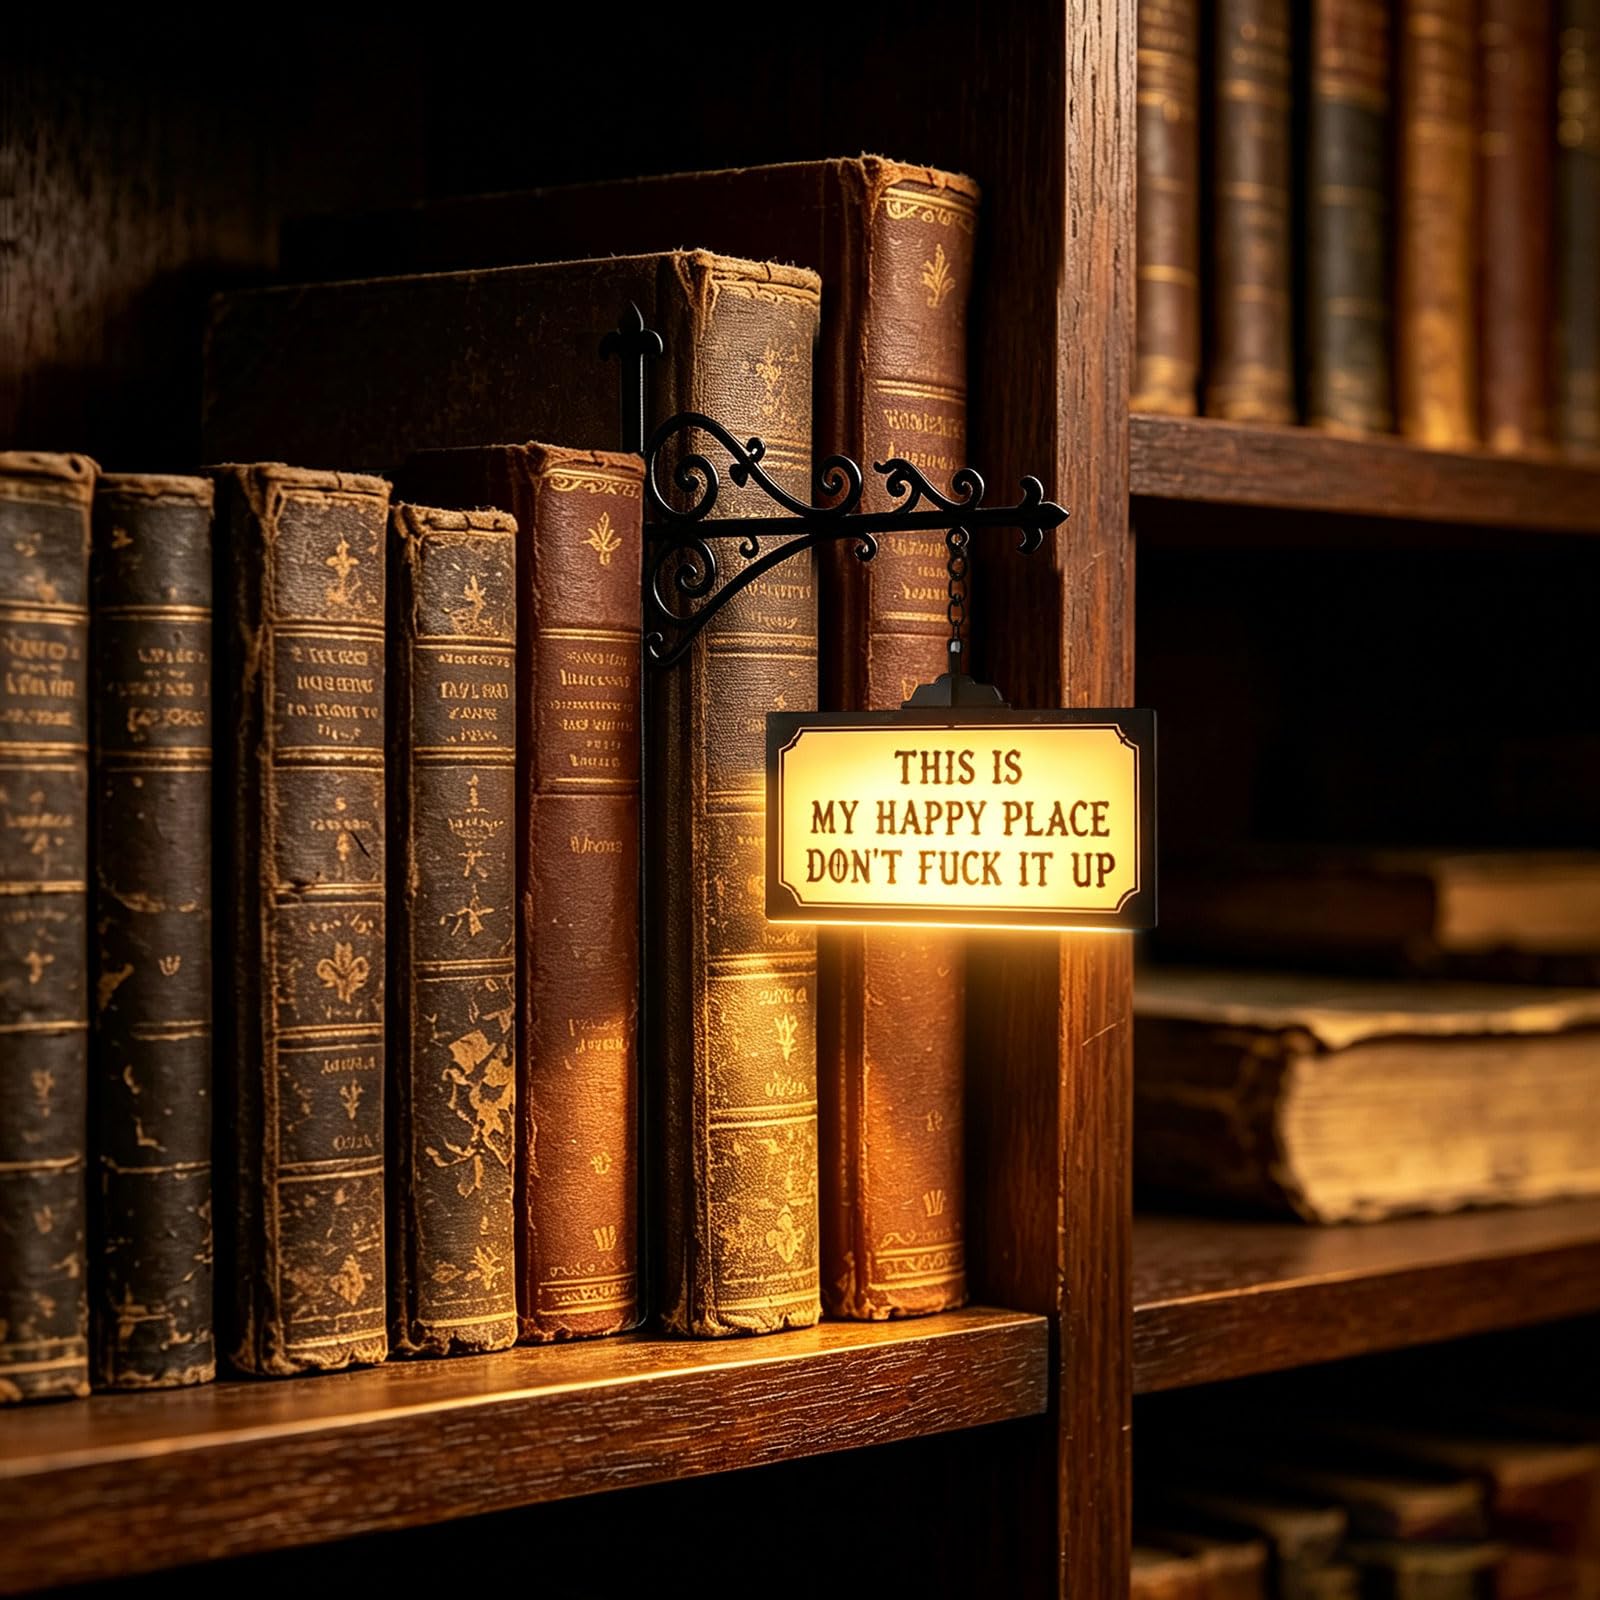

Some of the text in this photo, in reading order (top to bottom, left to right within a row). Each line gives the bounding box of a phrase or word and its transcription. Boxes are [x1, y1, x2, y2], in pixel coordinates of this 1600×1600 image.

[894, 749, 1023, 785] THIS IS
[810, 799, 1111, 837] MY HAPPY PLACE
[806, 848, 1116, 889] DON'T FUCK IT UP
